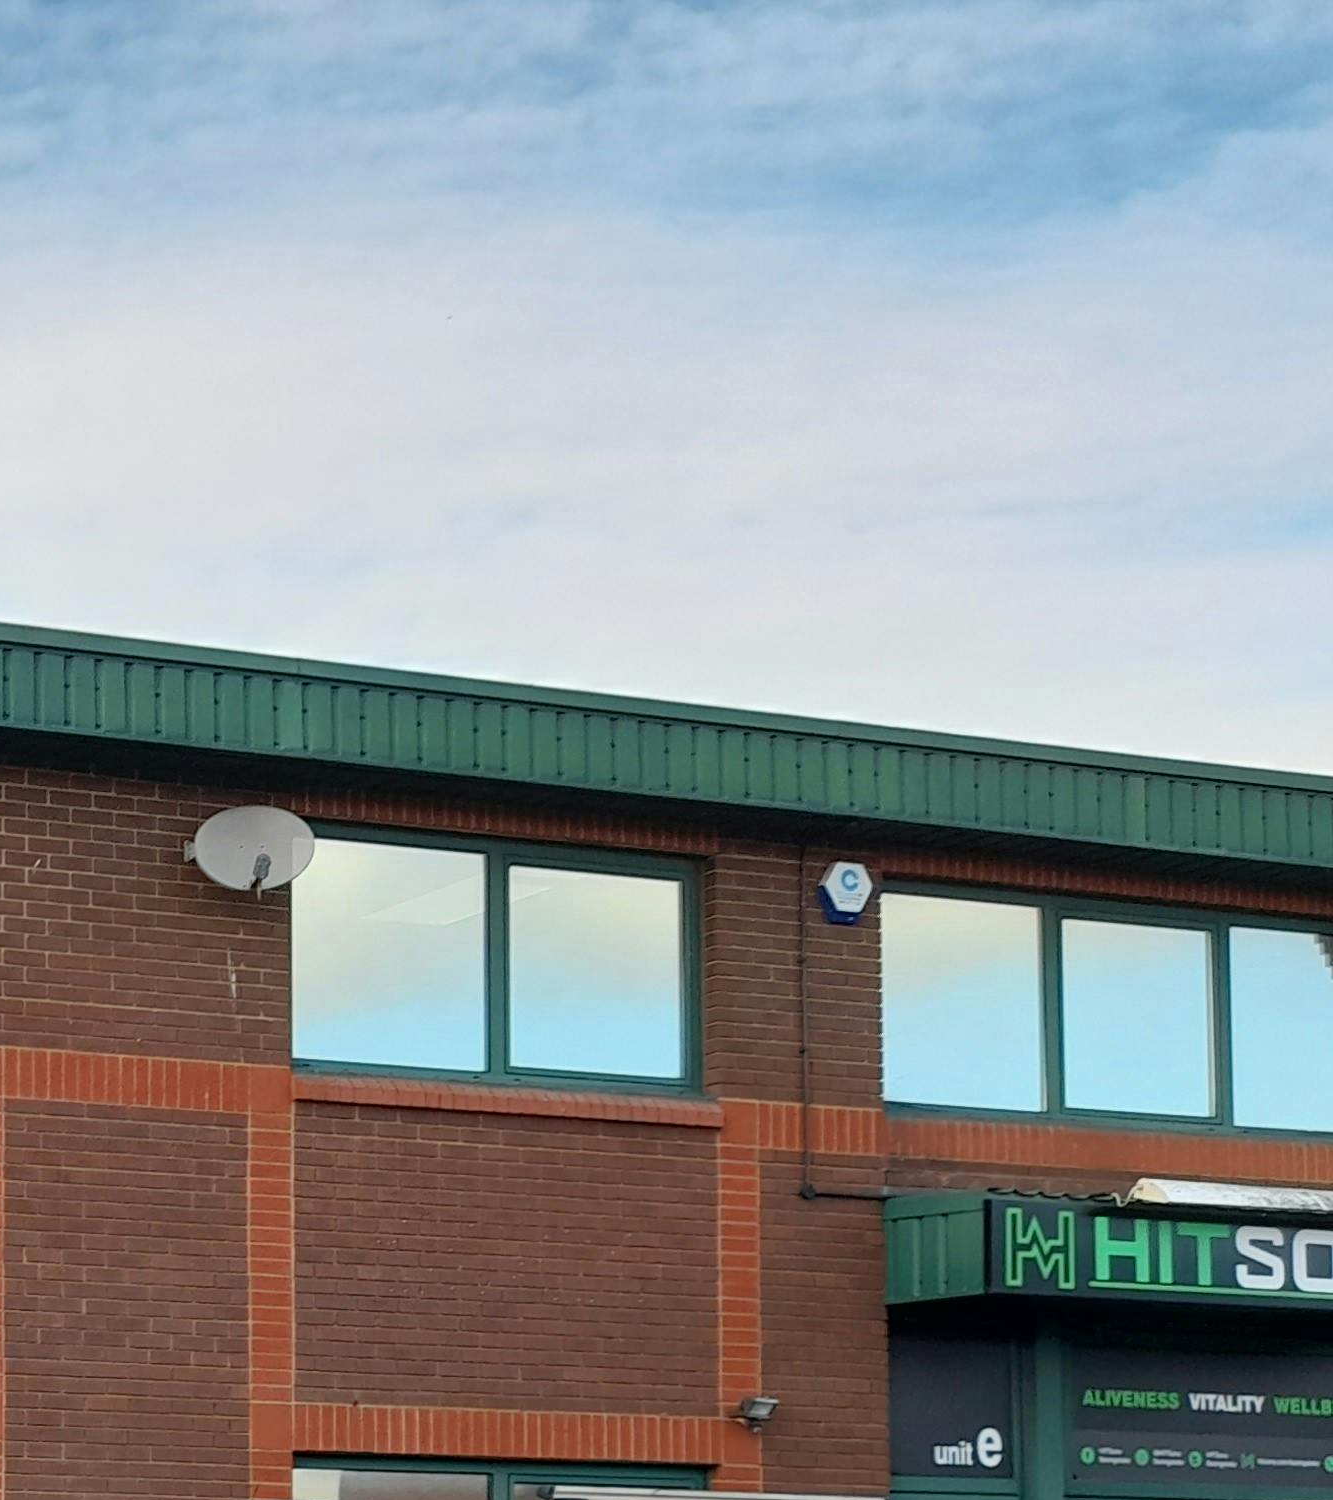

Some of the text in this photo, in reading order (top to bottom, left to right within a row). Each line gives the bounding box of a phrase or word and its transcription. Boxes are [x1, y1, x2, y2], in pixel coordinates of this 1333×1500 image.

[1083, 1389, 1333, 1417] ALIVENESS VITALITY WELLB
[933, 1427, 1003, 1468] unit e
